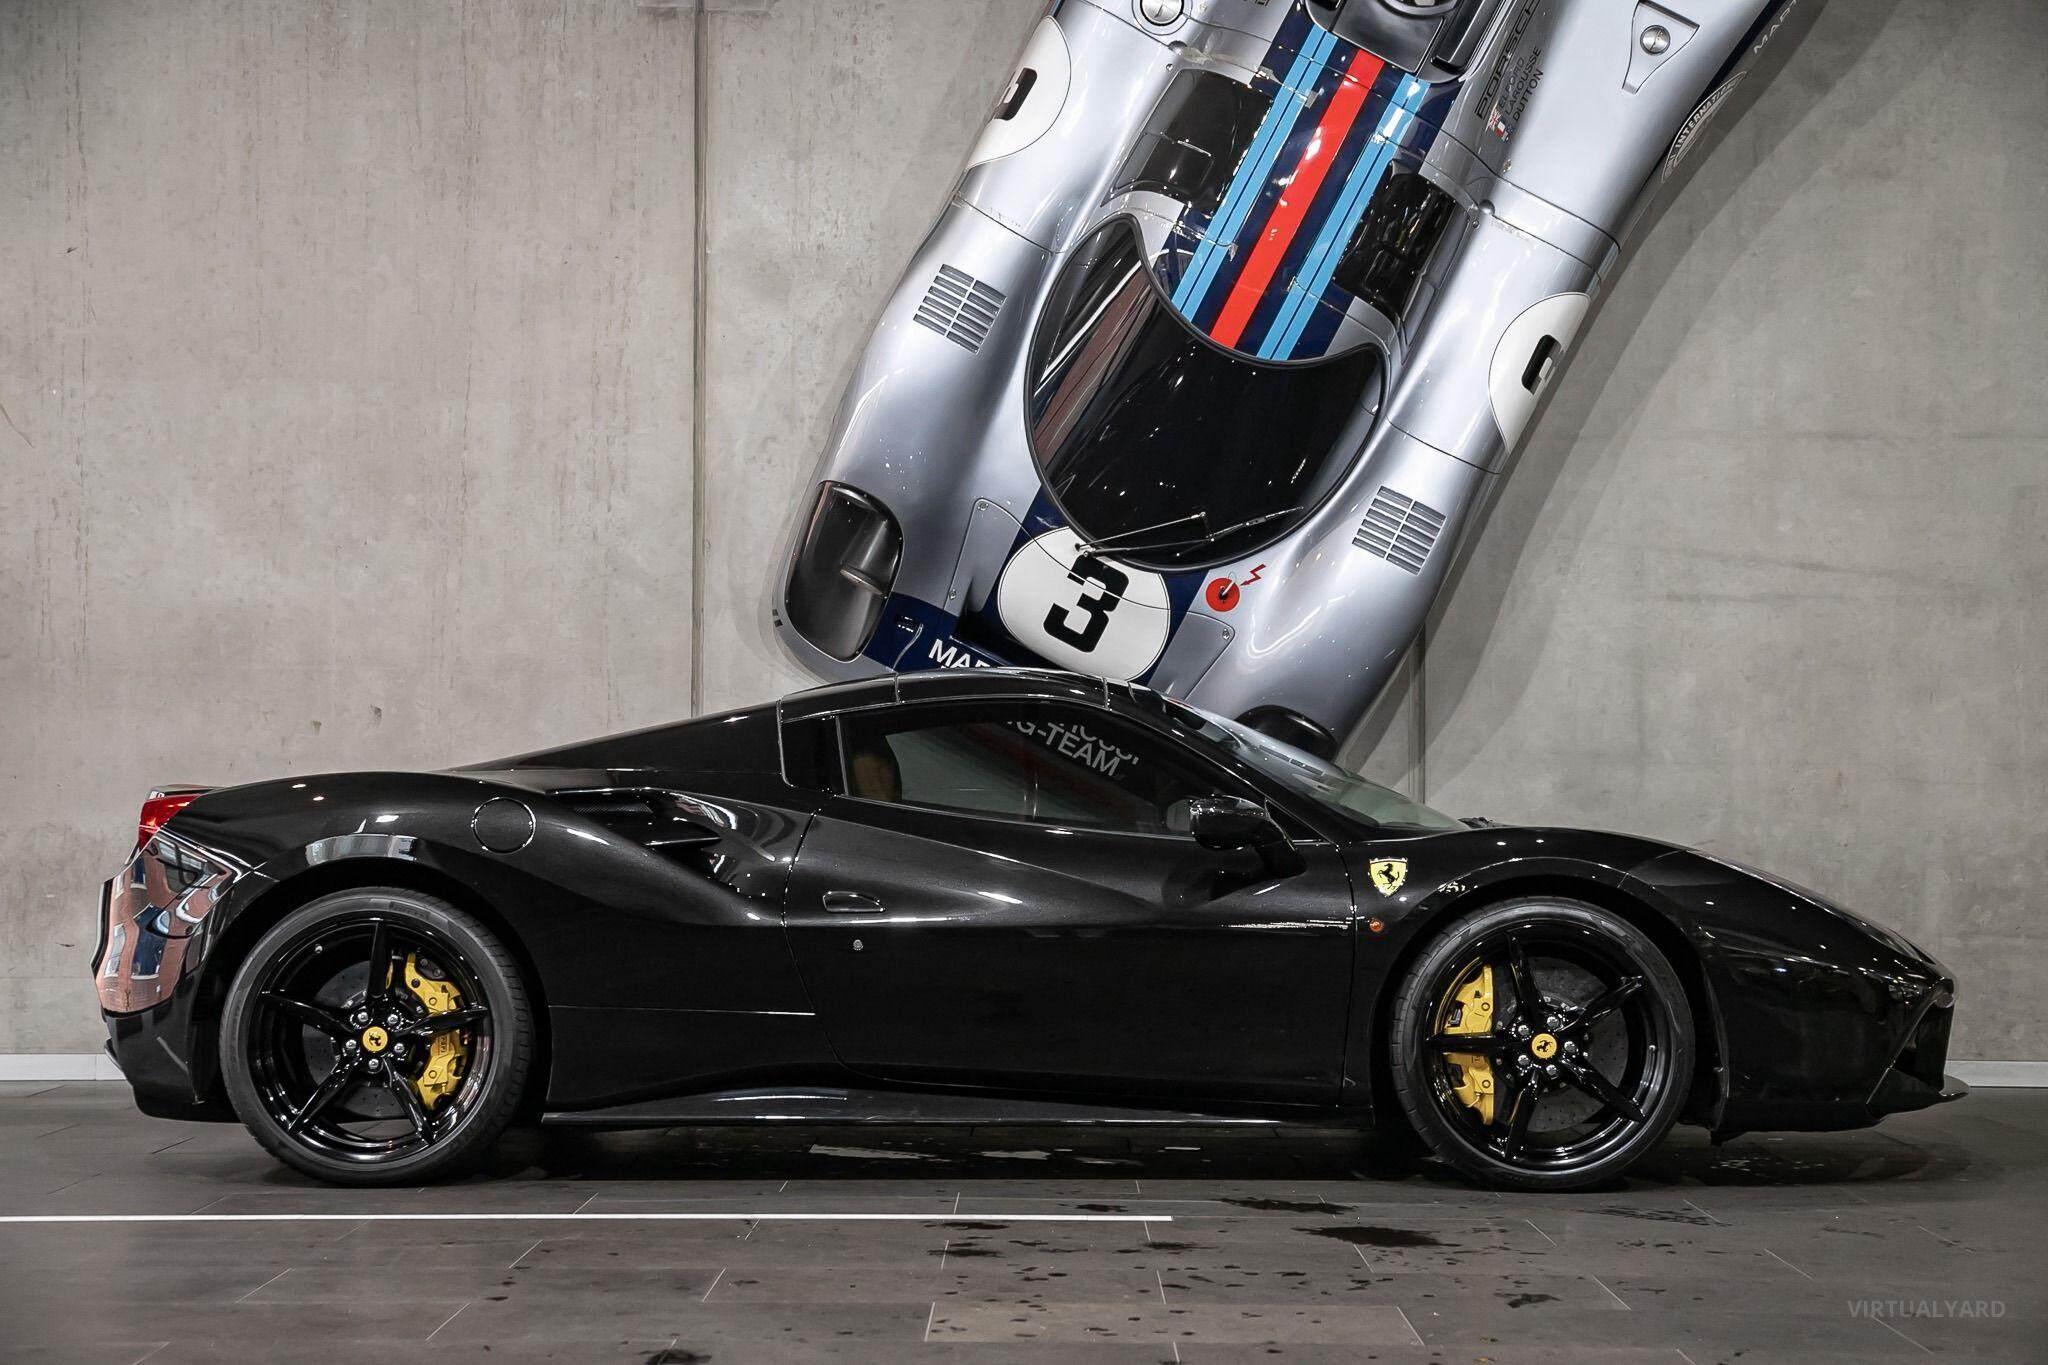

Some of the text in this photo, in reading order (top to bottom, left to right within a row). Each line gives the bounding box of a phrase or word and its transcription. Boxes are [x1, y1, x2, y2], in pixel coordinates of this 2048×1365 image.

[1499, 57, 1525, 109] ELFORD
[1505, 46, 1542, 115] LAROUSSE
[1512, 68, 1544, 121] DUTTON
[1043, 554, 1130, 653] 3
